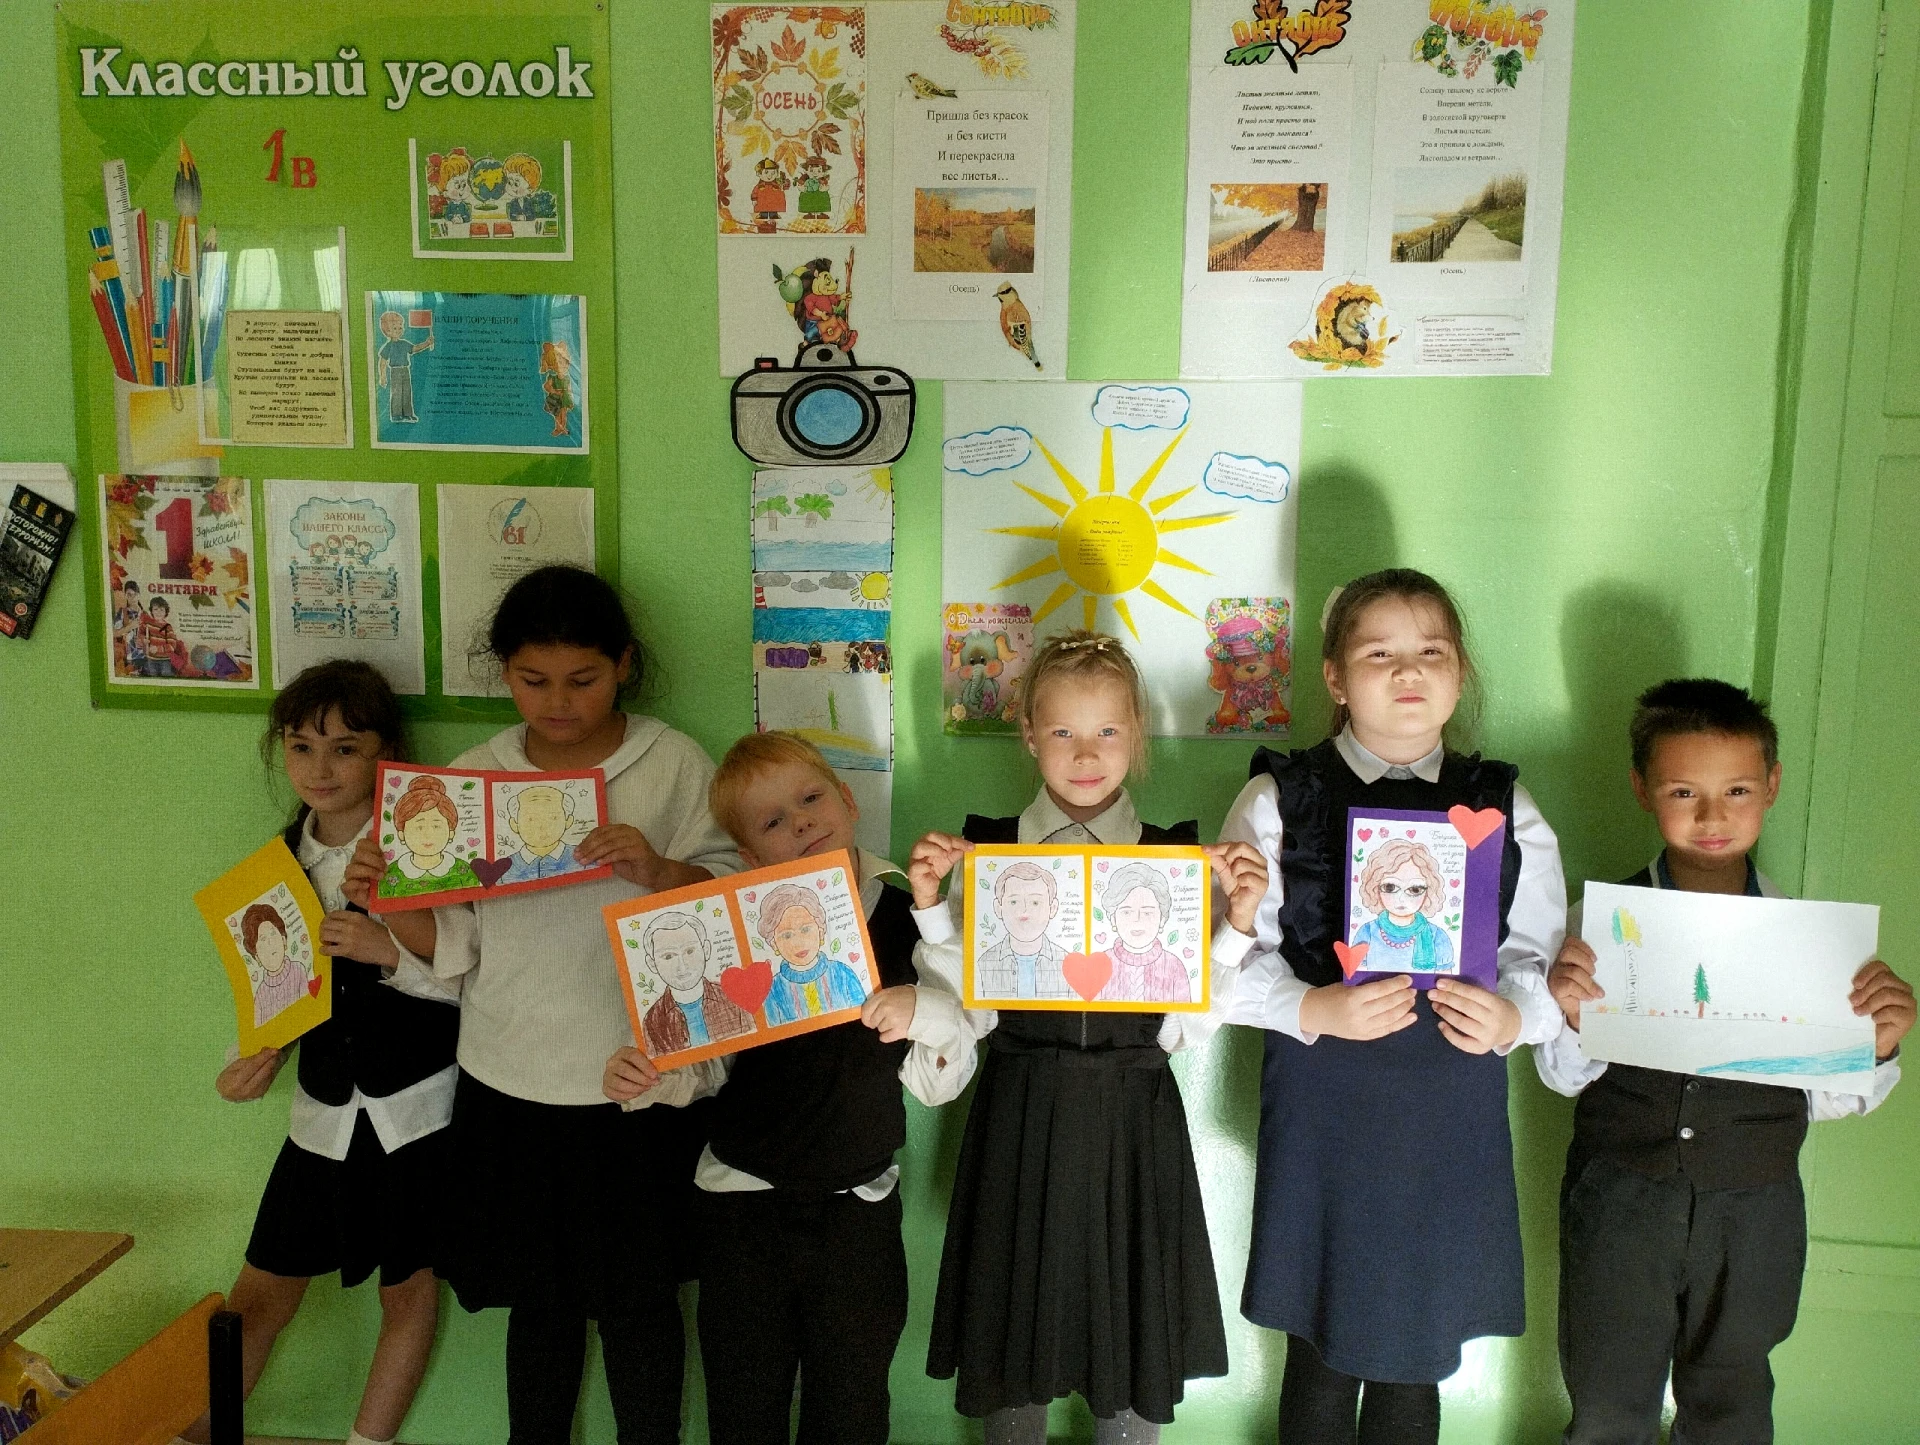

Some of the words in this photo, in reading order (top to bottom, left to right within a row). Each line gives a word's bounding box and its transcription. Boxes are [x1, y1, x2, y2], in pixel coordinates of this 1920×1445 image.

[79, 46, 368, 97] Классный
[384, 46, 595, 110] уголок
[762, 92, 818, 110] ОСЕНЬ
[927, 110, 970, 123] Пришла
[973, 110, 990, 120] без
[993, 112, 1029, 122] красок
[956, 130, 974, 140] без
[976, 132, 1007, 140] кисти
[938, 151, 946, 160] И
[950, 152, 1015, 163] перекрасила
[324, 512, 366, 521] ЗАКОНЫ
[302, 522, 344, 533] НАШЕГО
[348, 524, 388, 534] КЛАССА
[8, 523, 54, 554] ЕРРОРИЗМ!
[156, 498, 194, 579] 1
[148, 582, 218, 596] СЕНТЯБРЯ
